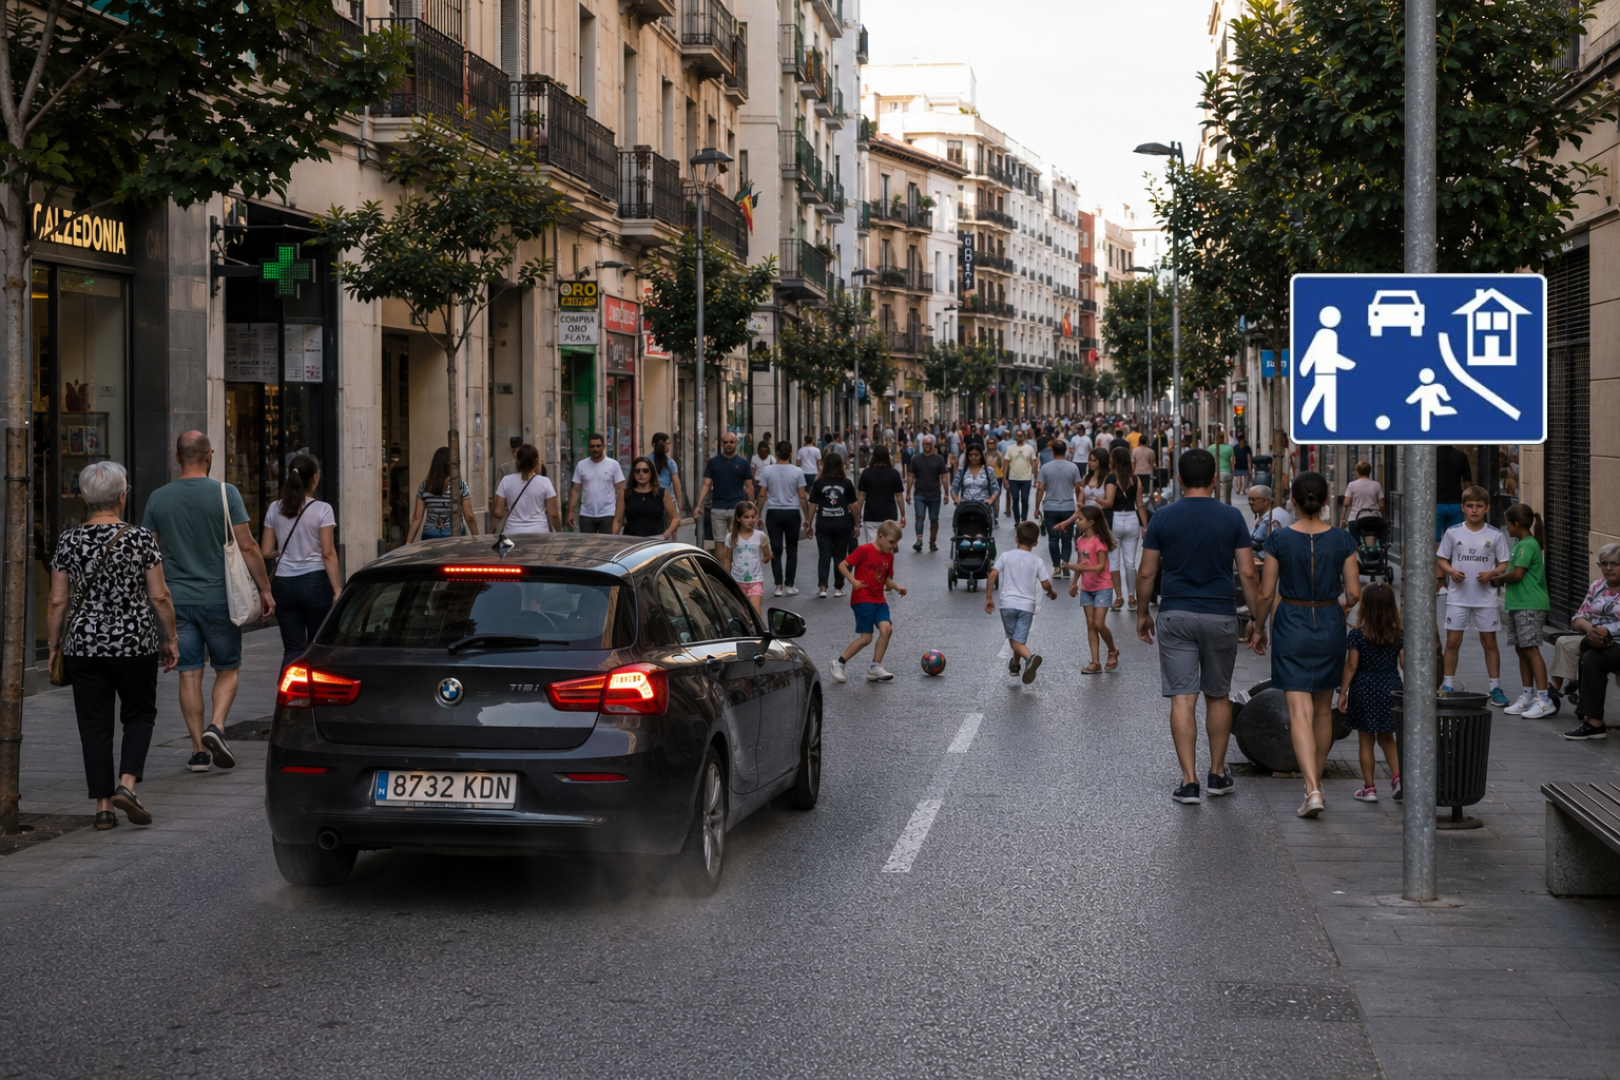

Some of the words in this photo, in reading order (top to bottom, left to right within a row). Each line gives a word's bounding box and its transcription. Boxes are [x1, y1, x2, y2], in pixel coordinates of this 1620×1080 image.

[33, 202, 127, 255] CALZEDONIA
[560, 283, 597, 296] ORO
[393, 774, 454, 798] 8732
[463, 775, 511, 799] KDN
